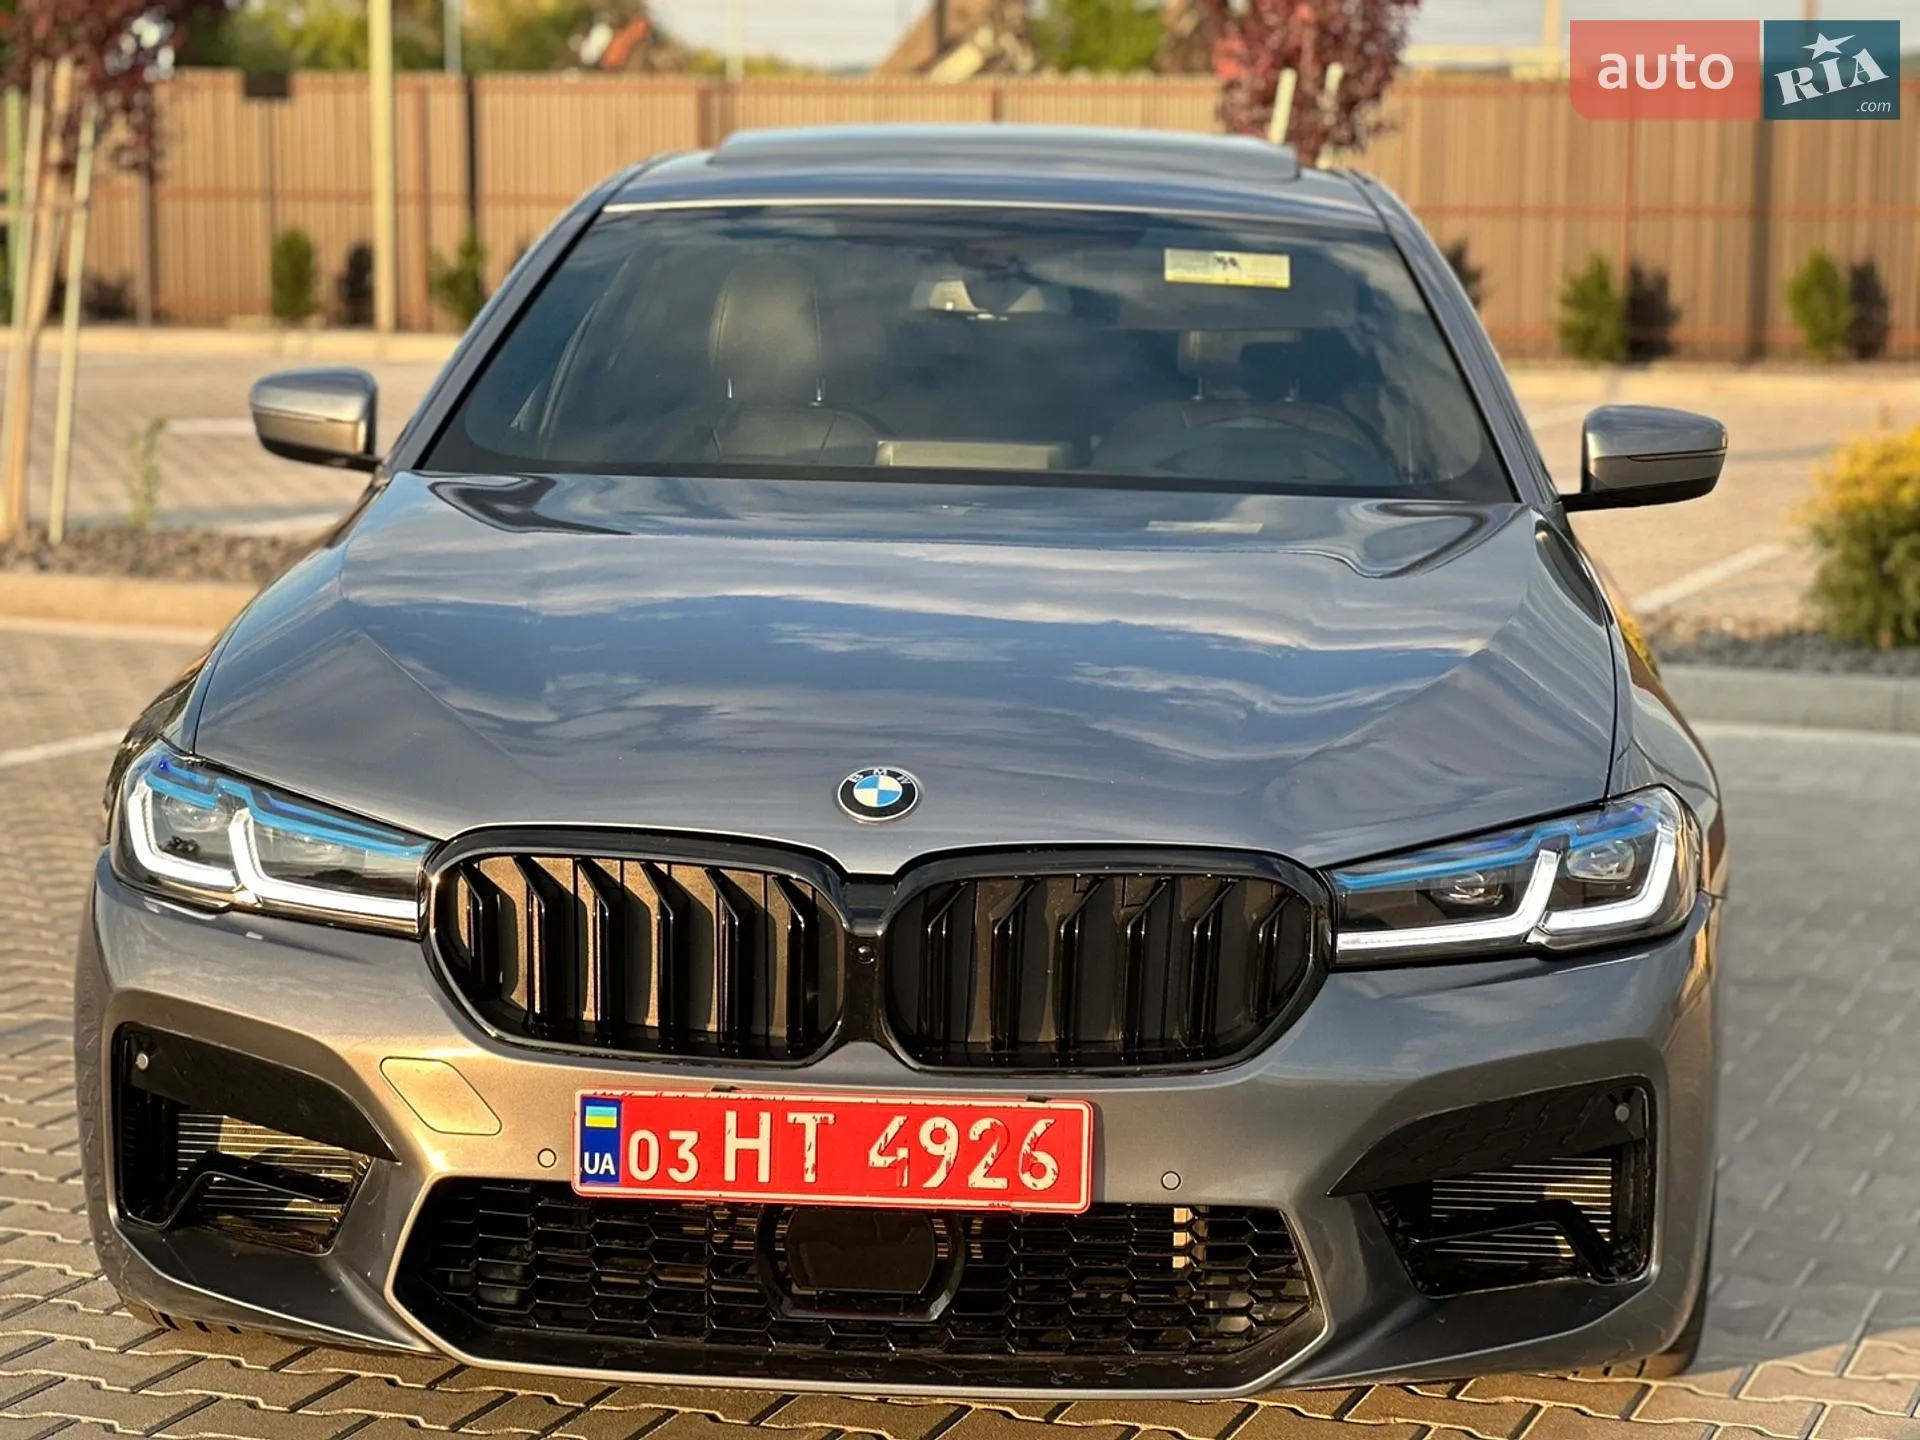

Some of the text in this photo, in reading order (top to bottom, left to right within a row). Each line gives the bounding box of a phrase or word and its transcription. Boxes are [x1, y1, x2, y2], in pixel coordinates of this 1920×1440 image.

[846, 767, 912, 784] BMW
[628, 1109, 1061, 1192] 03 HT 4926
[583, 1151, 617, 1176] UA
